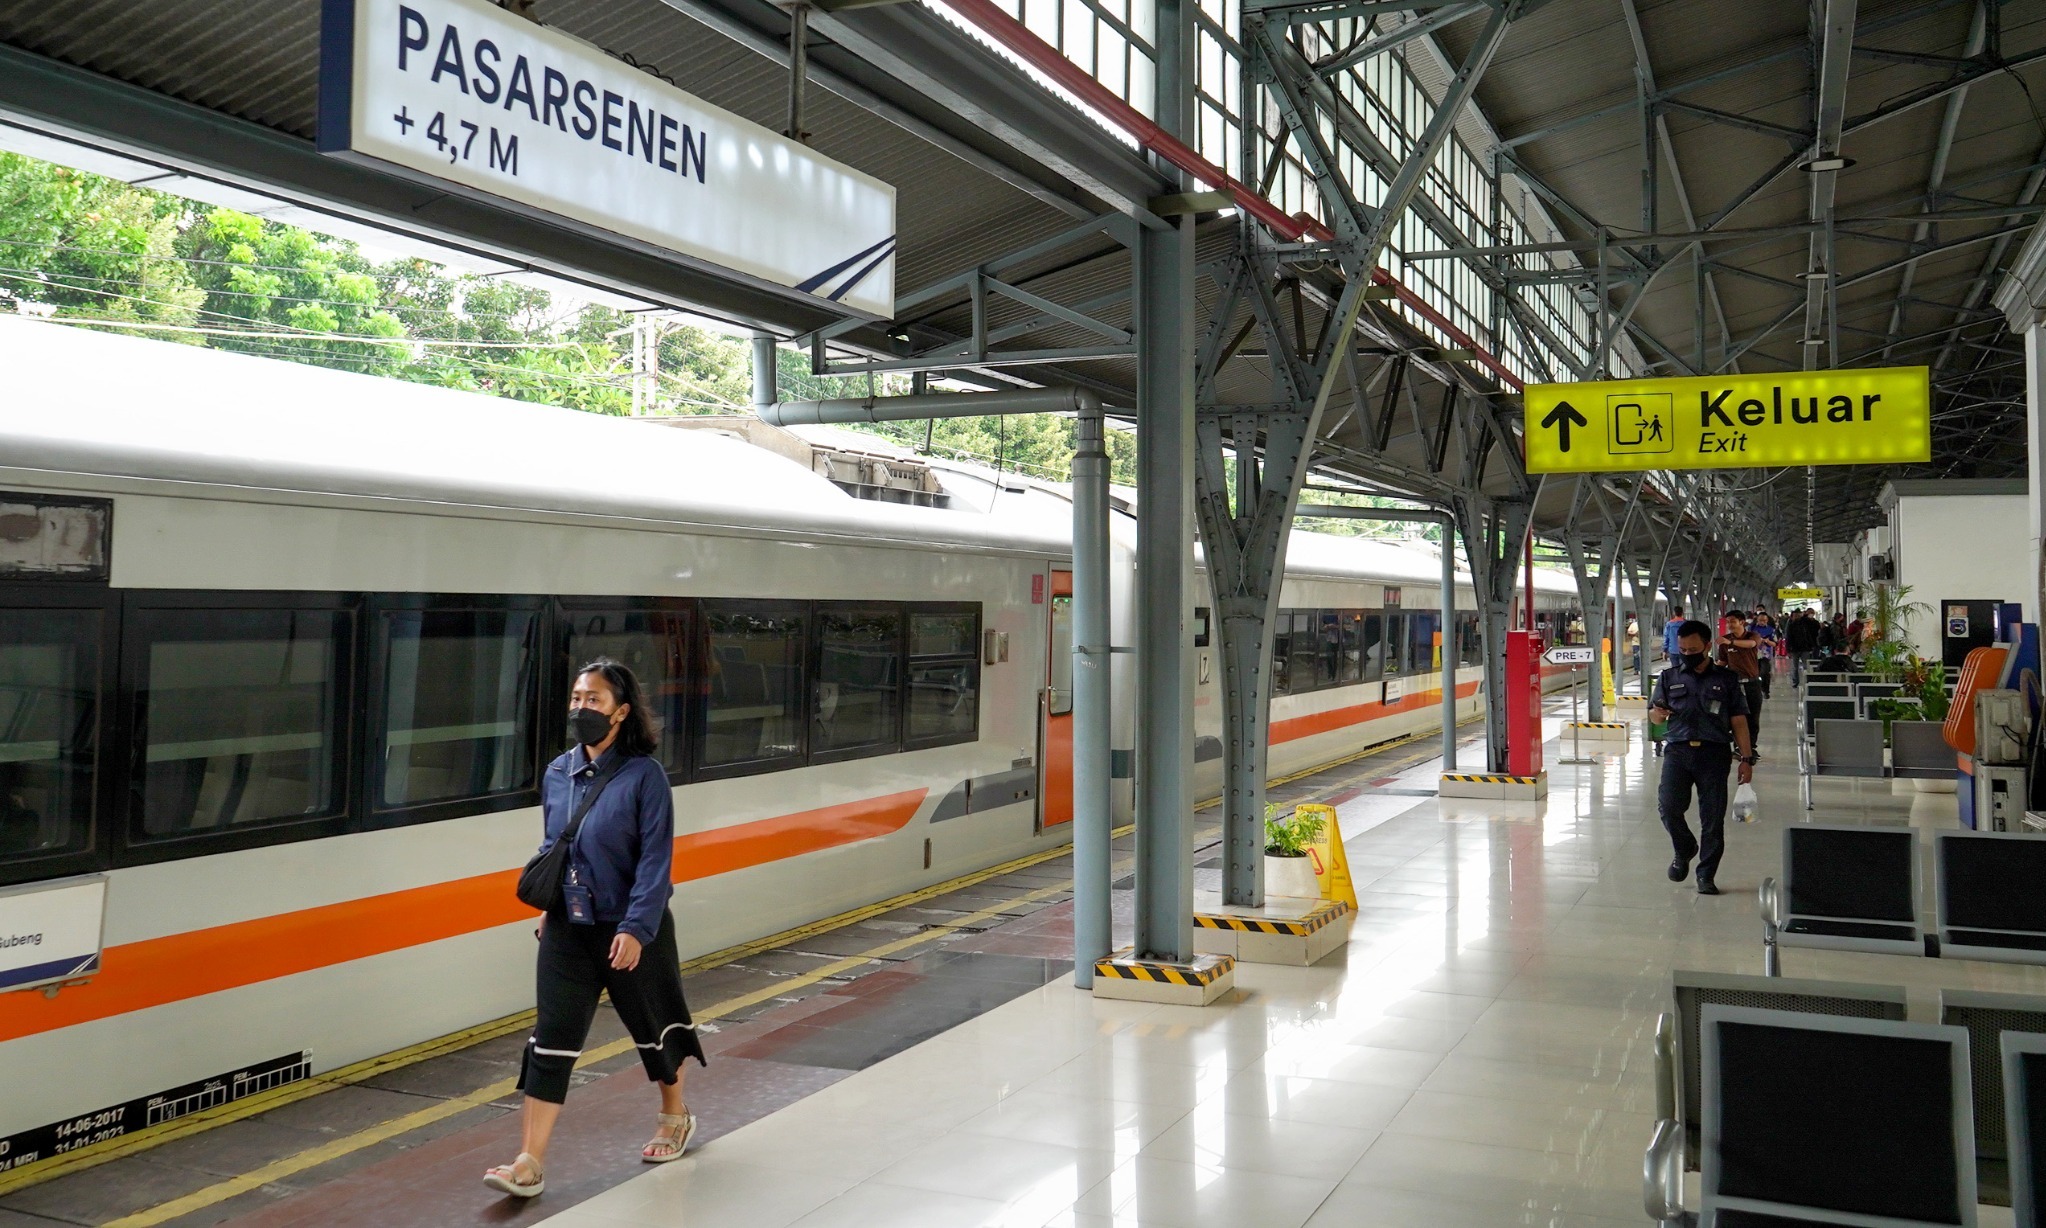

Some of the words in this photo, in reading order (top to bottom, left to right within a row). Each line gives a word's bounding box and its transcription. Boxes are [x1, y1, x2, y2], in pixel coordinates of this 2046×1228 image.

[398, 5, 707, 184] PASARSENEN
[394, 105, 415, 135] +
[426, 110, 480, 165] 4,7
[489, 126, 519, 177] M
[1700, 386, 1881, 428] Keluar
[1698, 431, 1748, 453] Exit
[1556, 651, 1576, 660] PRE
[1586, 651, 1591, 660] 7
[55, 1107, 126, 1139] 14-06-2017
[54, 1125, 125, 1154] 31-01-2023
